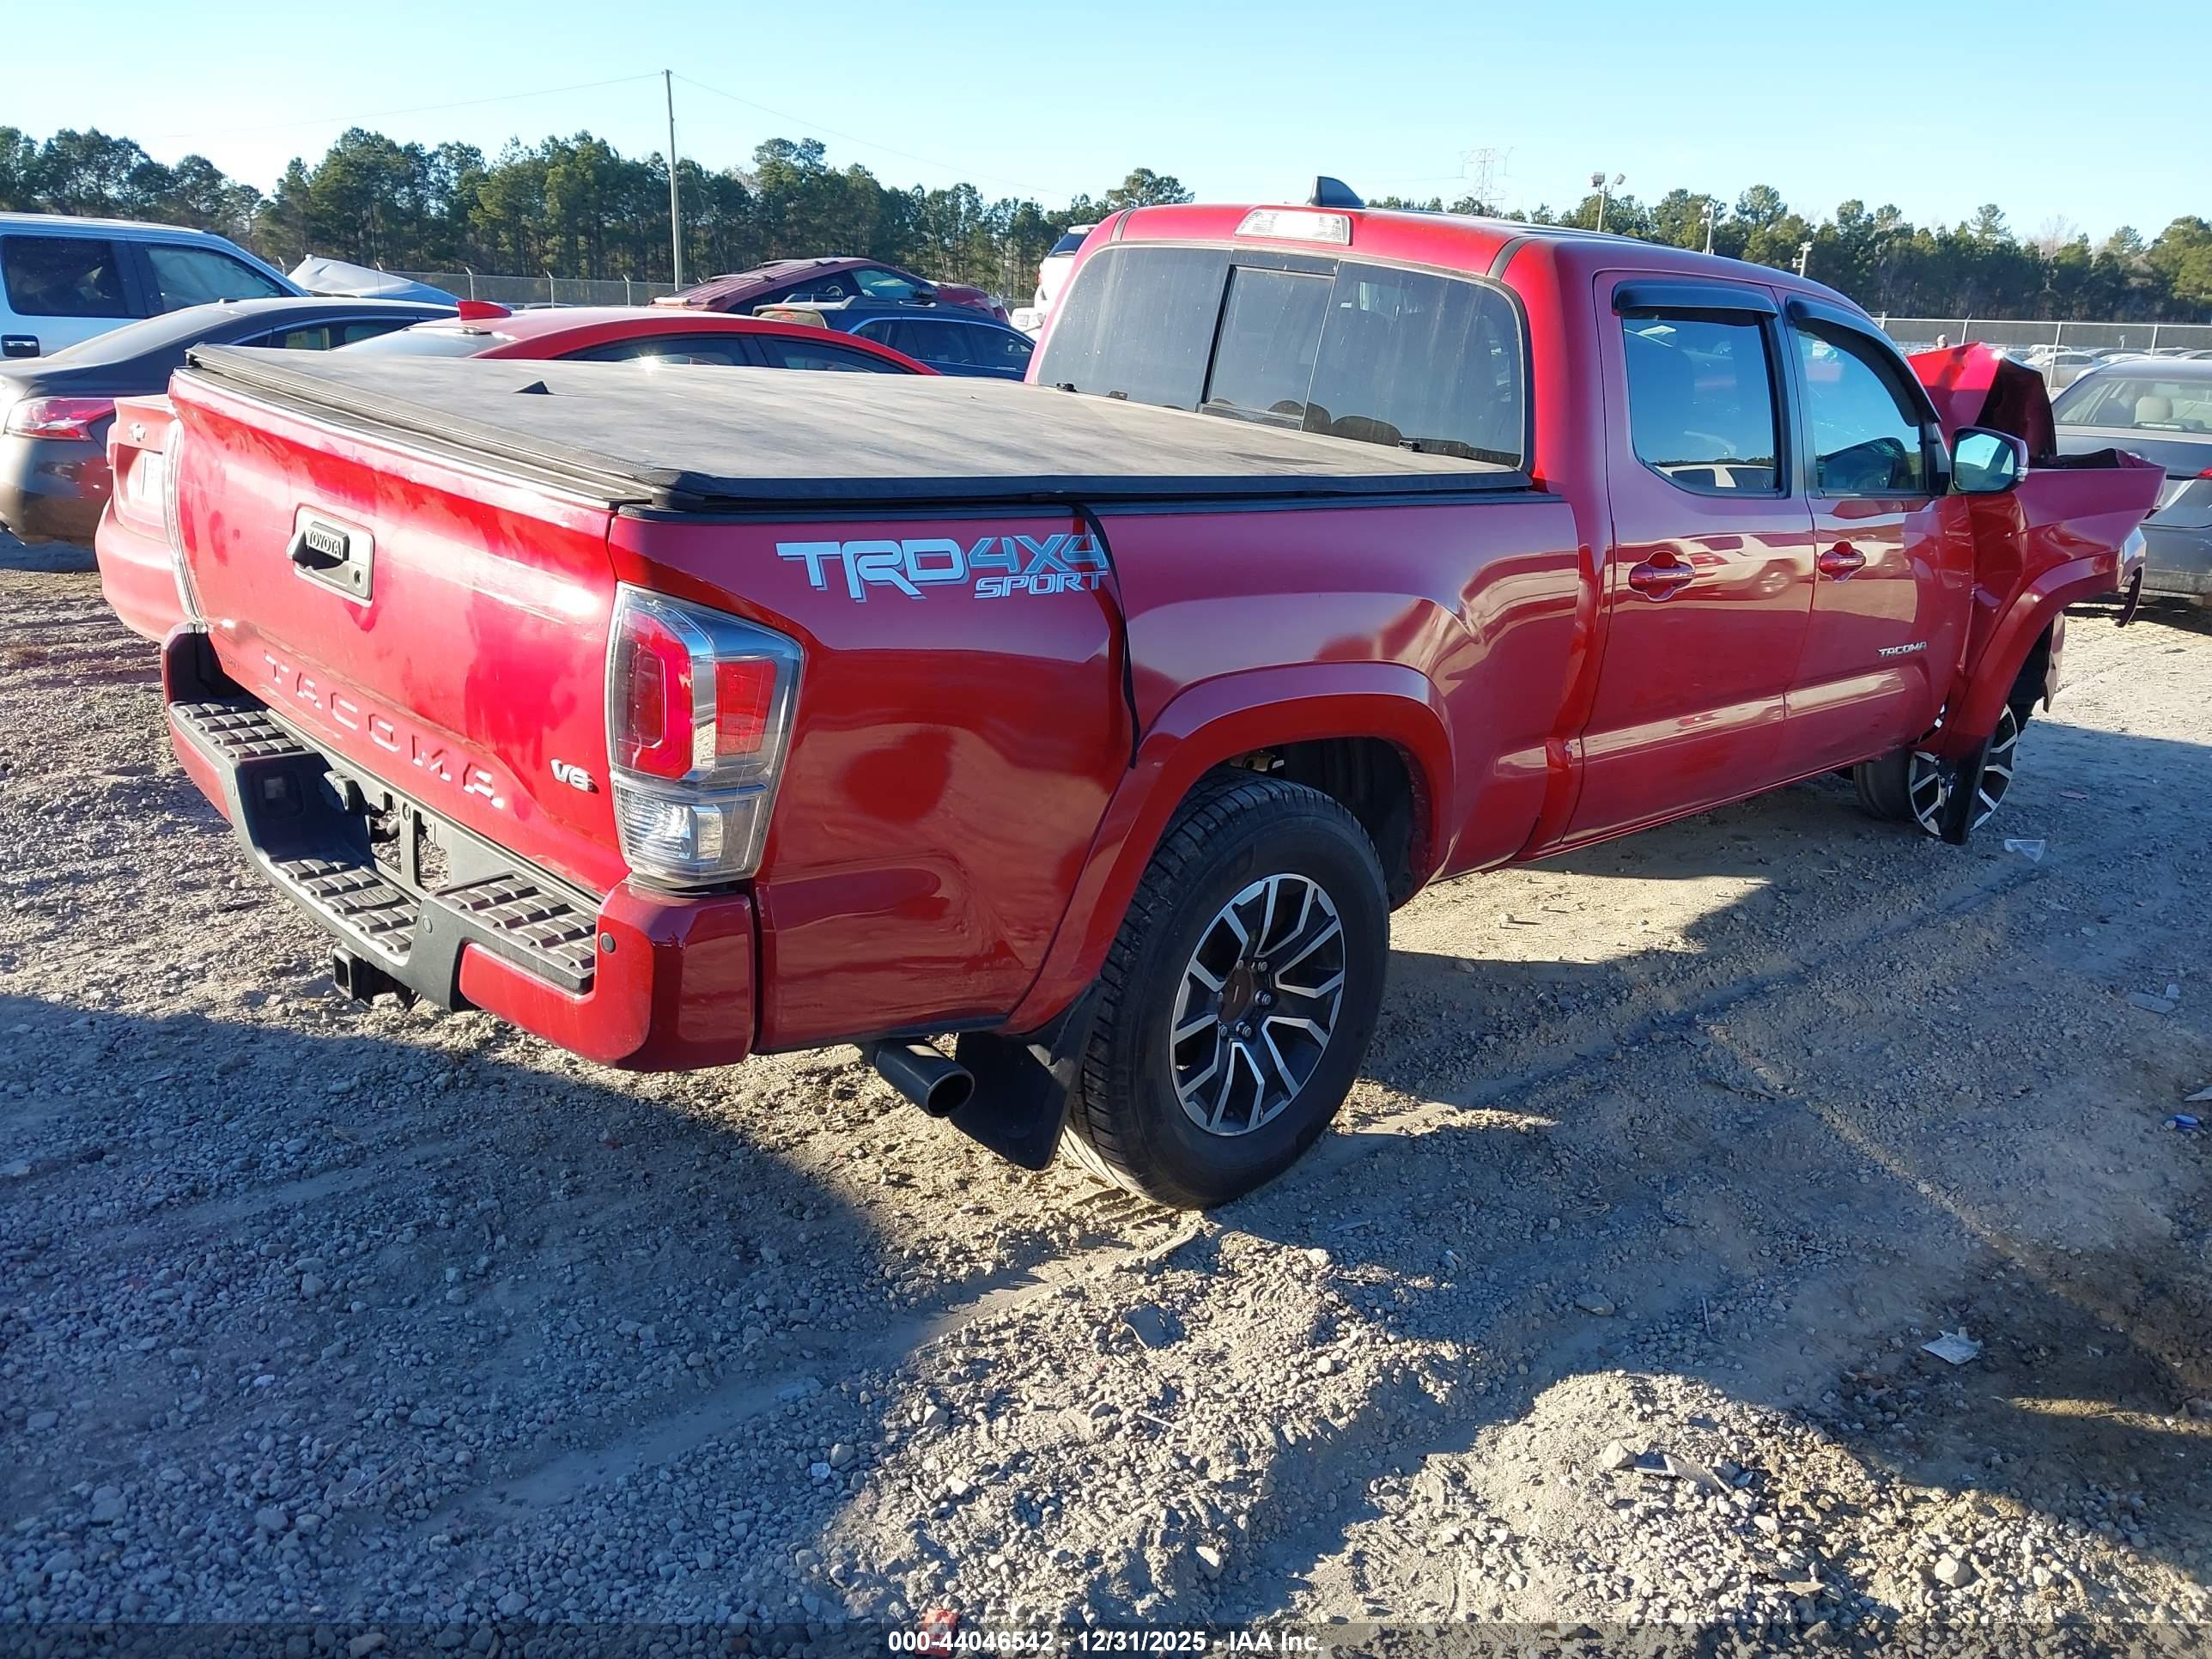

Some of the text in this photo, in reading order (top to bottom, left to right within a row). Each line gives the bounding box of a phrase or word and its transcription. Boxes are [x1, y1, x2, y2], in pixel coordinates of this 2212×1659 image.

[308, 529, 342, 557] TOYOTA
[775, 538, 969, 603] TRD
[974, 571, 1109, 599] SPORT
[1878, 641, 1927, 657] TACOMA
[264, 650, 505, 810] TACOMA
[550, 758, 592, 793] V6
